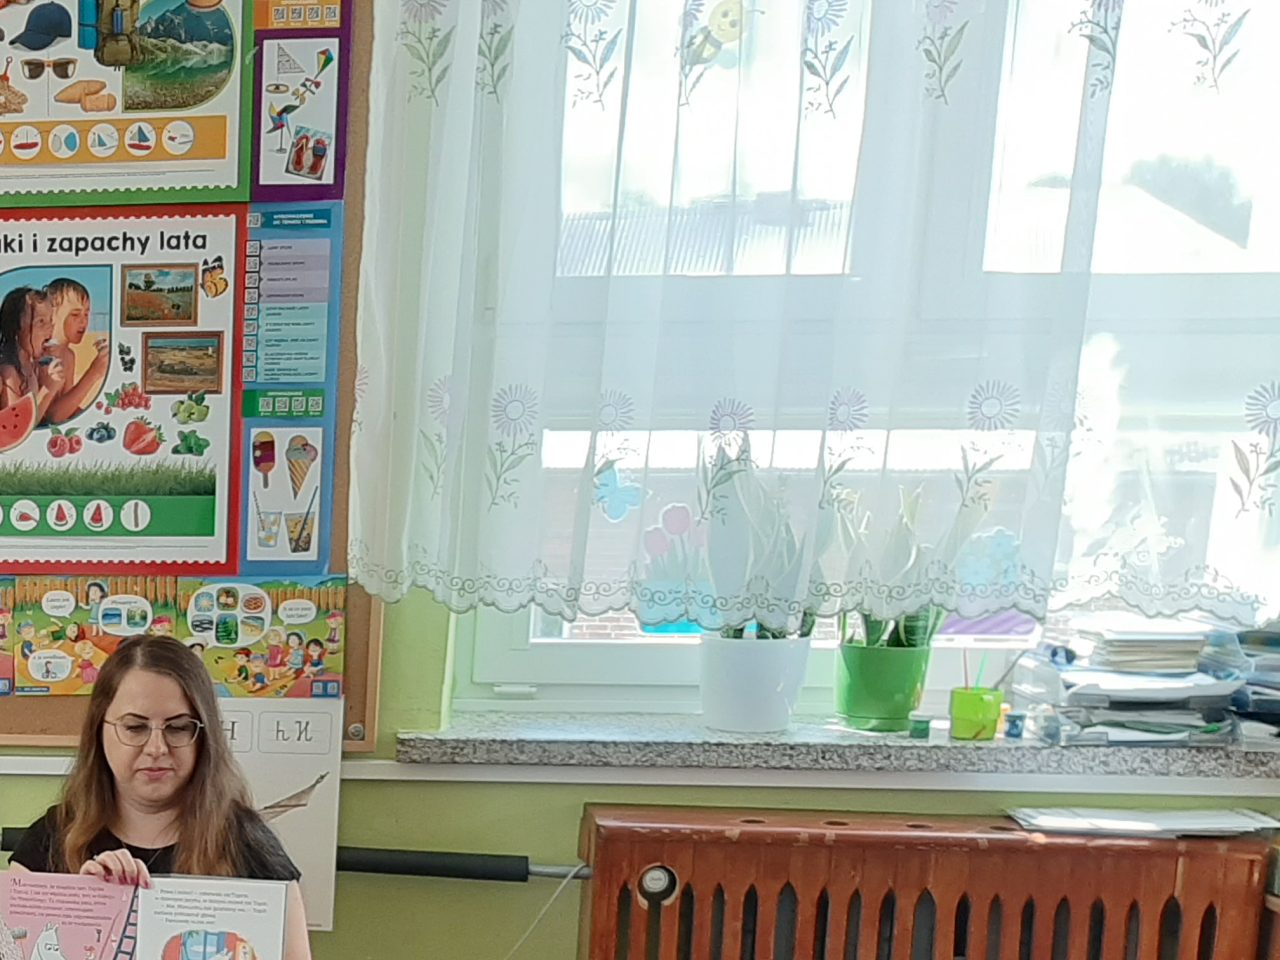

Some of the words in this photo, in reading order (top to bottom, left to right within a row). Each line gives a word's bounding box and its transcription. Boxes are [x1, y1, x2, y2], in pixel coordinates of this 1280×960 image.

[32, 233, 38, 253] i
[46, 231, 150, 257] zapachy
[160, 230, 207, 250] lata
[275, 720, 290, 741] h
